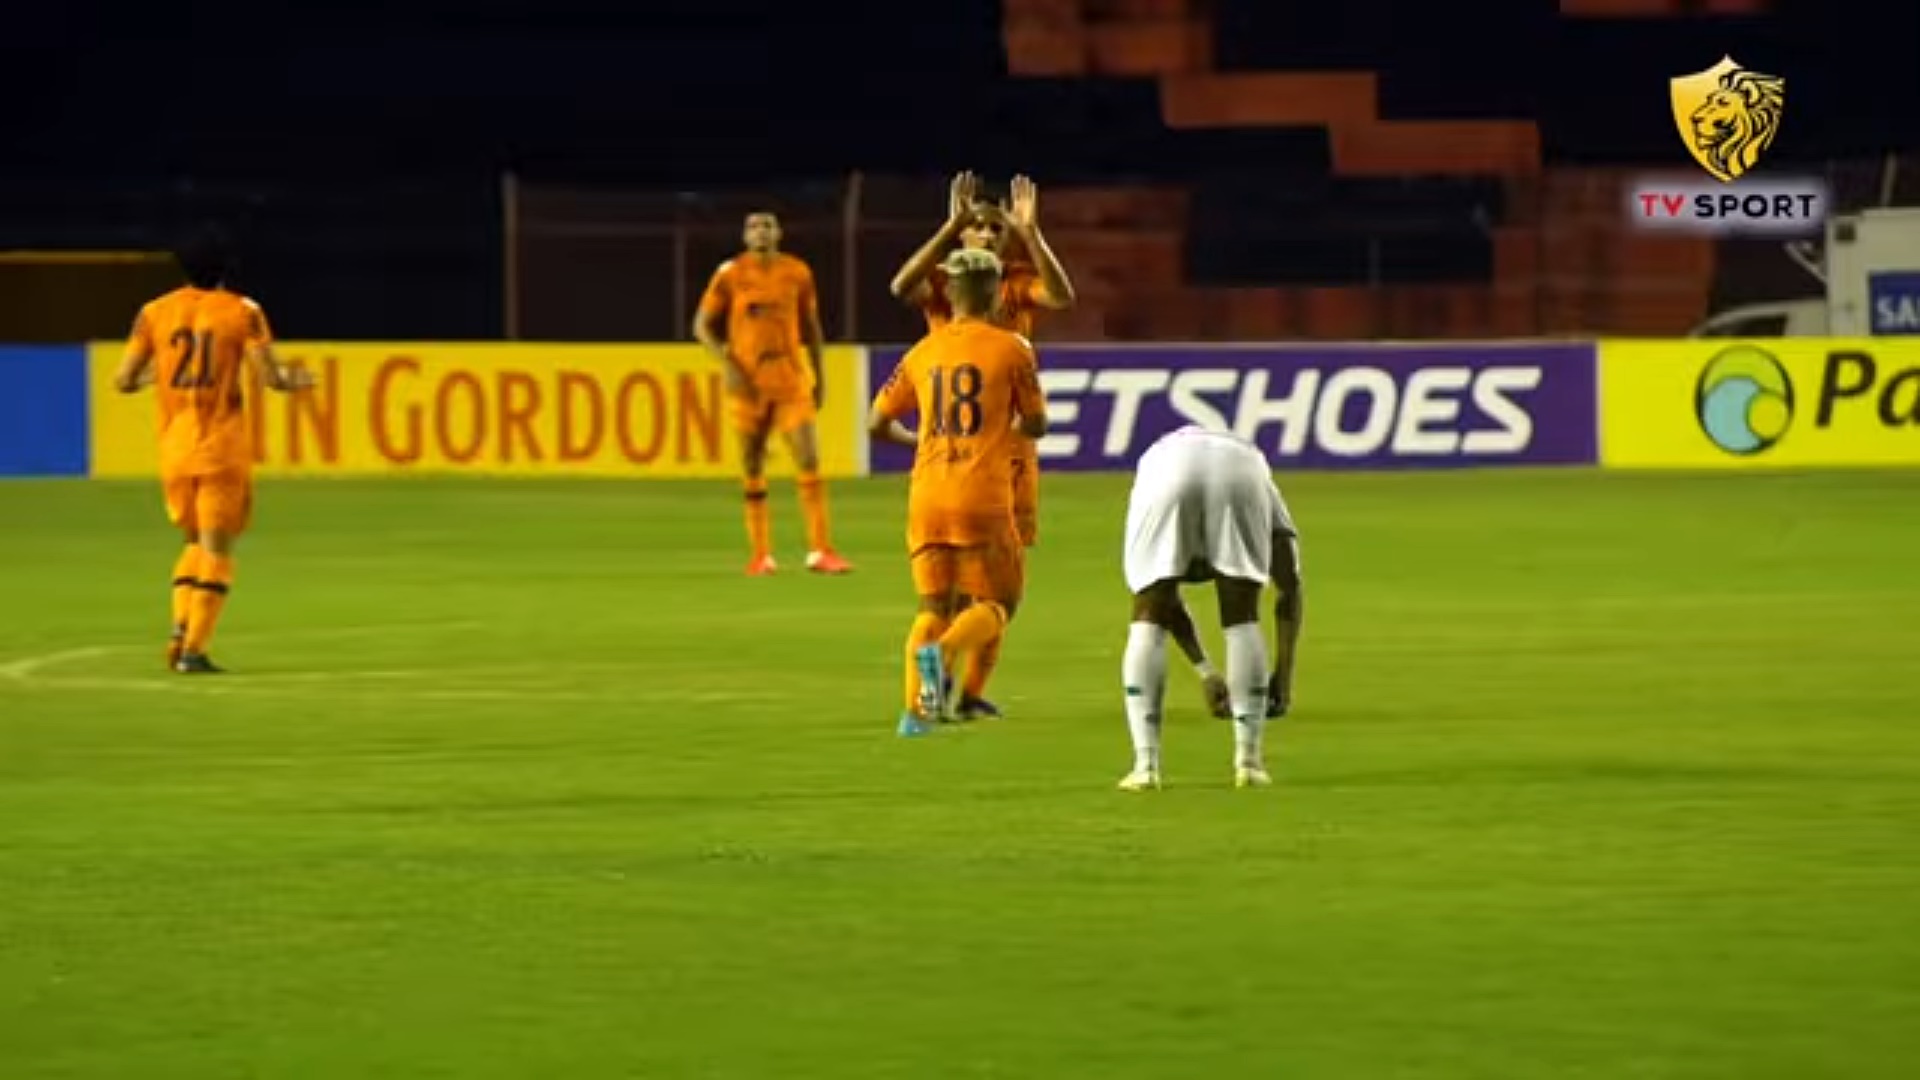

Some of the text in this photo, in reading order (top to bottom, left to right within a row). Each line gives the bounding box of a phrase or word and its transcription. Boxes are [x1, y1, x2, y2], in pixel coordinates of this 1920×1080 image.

[171, 327, 214, 388] 21
[1815, 351, 1920, 427] Pa
[368, 355, 722, 465] GORDON
[930, 364, 982, 436] 18
